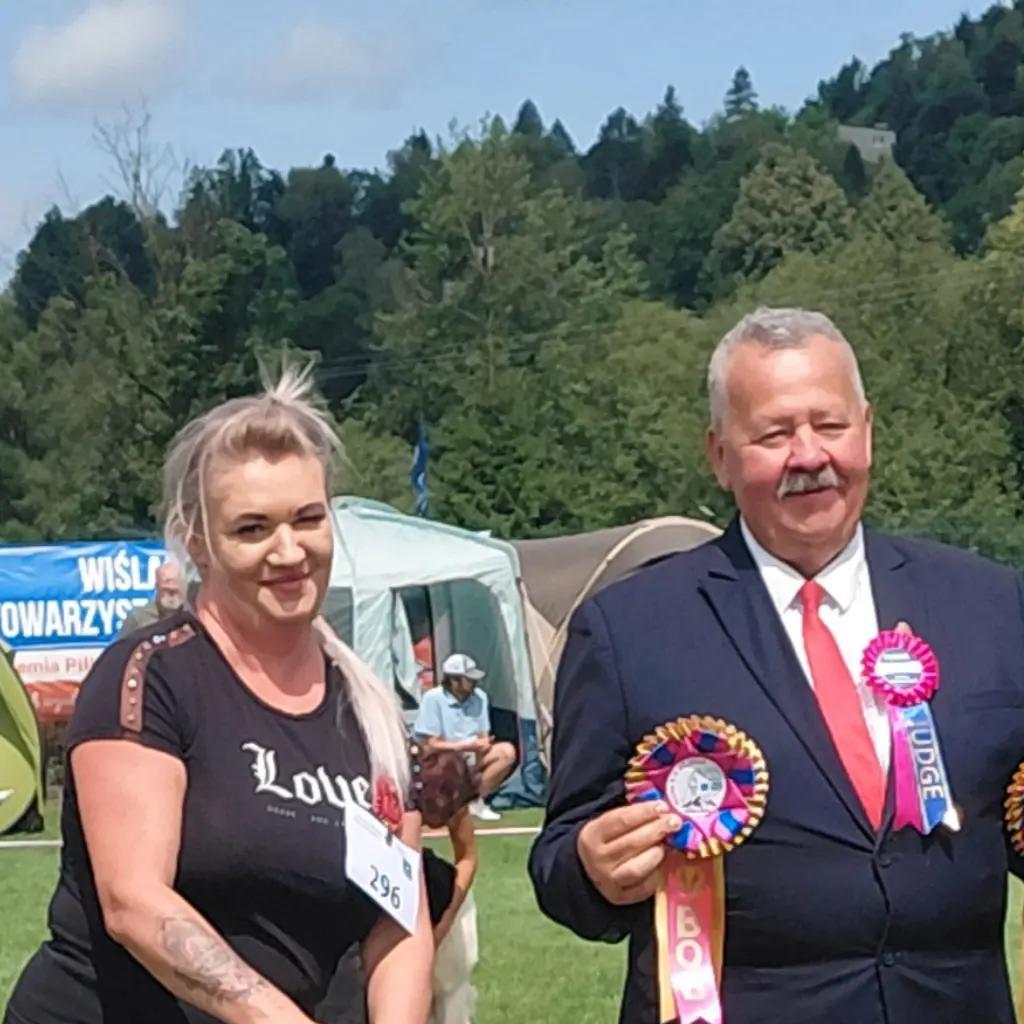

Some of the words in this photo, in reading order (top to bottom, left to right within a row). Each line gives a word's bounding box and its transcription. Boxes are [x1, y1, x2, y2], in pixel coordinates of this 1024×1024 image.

[1, 598, 149, 639] OWARZYS
[242, 742, 372, 809] Love
[908, 712, 945, 800] JUDGE
[370, 865, 401, 910] 296
